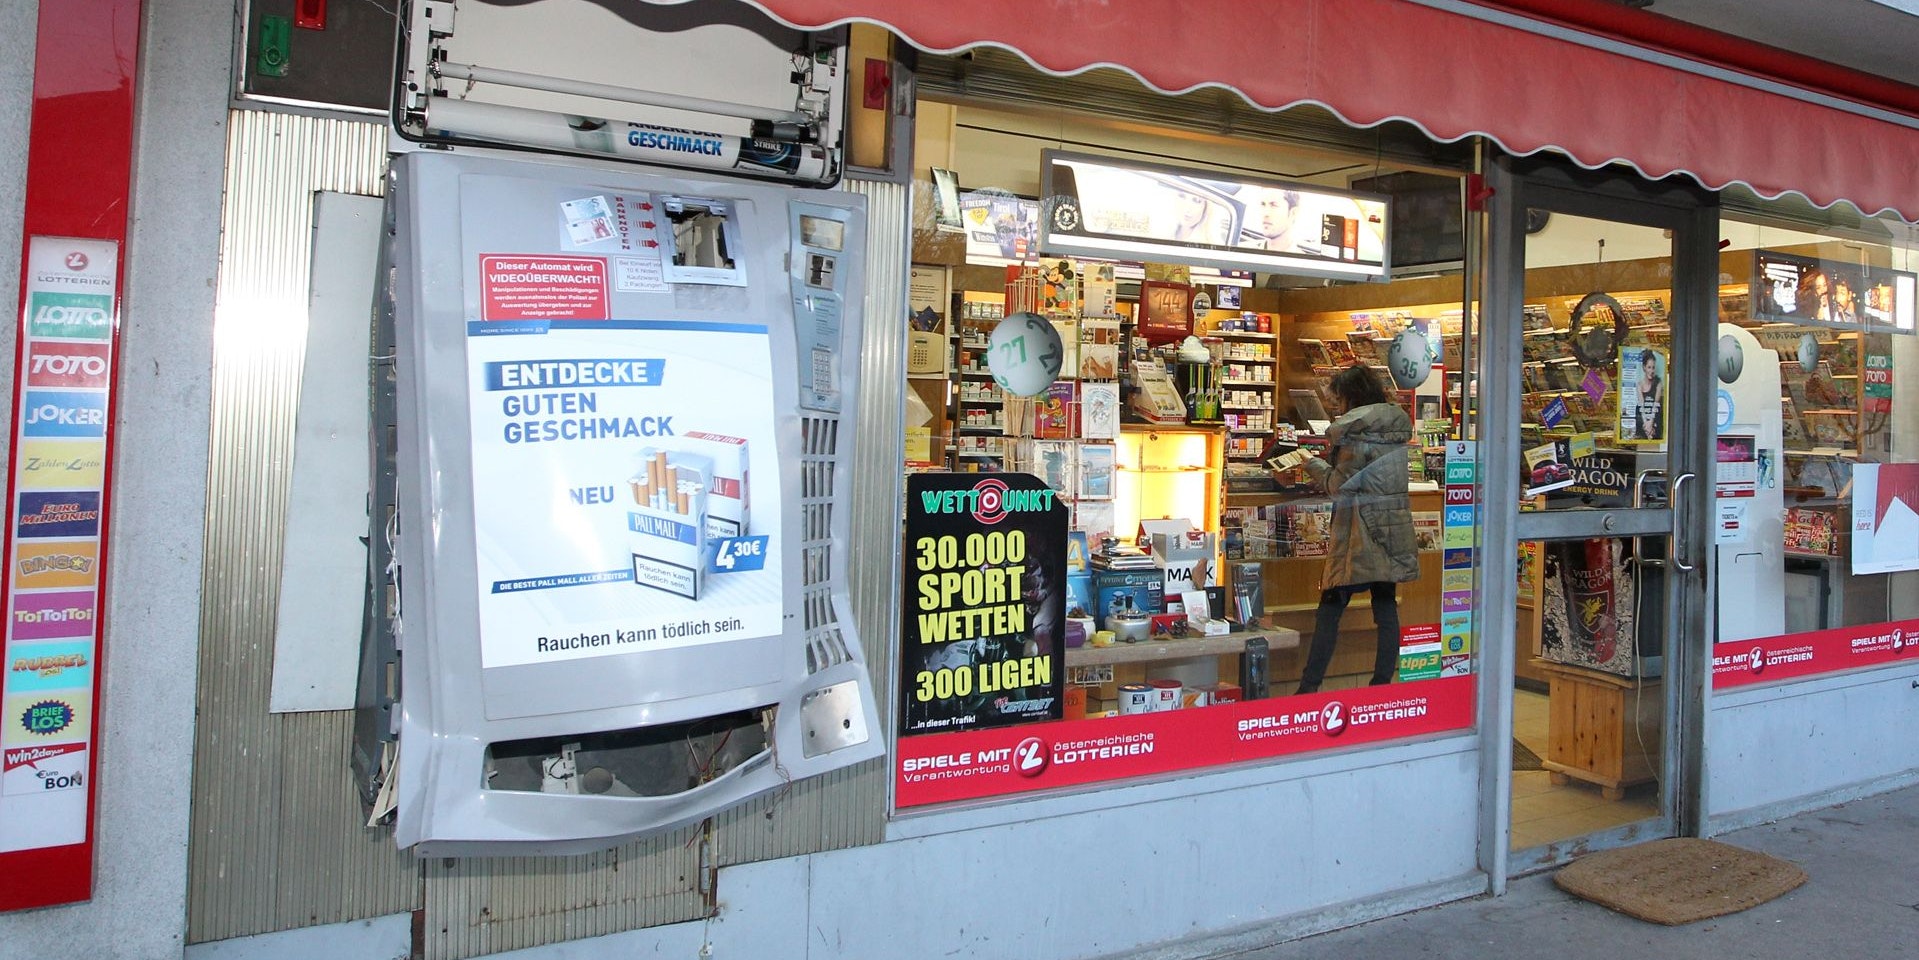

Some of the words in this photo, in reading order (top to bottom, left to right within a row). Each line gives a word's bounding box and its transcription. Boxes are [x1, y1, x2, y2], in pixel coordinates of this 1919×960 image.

[628, 130, 722, 157] GESCHMACK
[496, 262, 527, 270] Dieser
[530, 262, 571, 271] Automat
[572, 263, 593, 272] wird
[38, 276, 111, 286] LOTTERIEN
[489, 272, 600, 284] VIDEOÜBERWACHT!
[34, 305, 109, 326] LOTTO
[31, 354, 106, 376] TOTO
[501, 361, 648, 387] ENTDECKE
[1400, 357, 1419, 379] 35
[503, 392, 597, 417] GUTEN
[27, 404, 104, 426] JOKER
[504, 416, 674, 444] GESCHMACK
[1572, 457, 1612, 470] WILD
[1448, 467, 1473, 479] LOTTO
[1568, 468, 1629, 489] RAGON
[569, 485, 614, 506] NEU
[1447, 489, 1472, 500] TOTO
[1562, 486, 1592, 494] ENERGY
[1594, 488, 1619, 496] DRINK
[1447, 510, 1472, 522] JOKER
[634, 515, 654, 532] PALL
[654, 519, 677, 539] MALL
[915, 529, 1026, 572] 30.000
[639, 563, 671, 578] Rauchen
[673, 571, 691, 583] kann
[643, 573, 669, 586] tödlich
[1167, 565, 1213, 582] MAK
[1573, 569, 1603, 579] WILD
[499, 582, 512, 590] DIE
[513, 580, 537, 589] BESTE
[537, 579, 557, 587] PALL
[557, 577, 578, 585] MALL
[917, 566, 1026, 611] SPORT
[917, 603, 1026, 645] WETTEN
[537, 632, 611, 653] Rauchen
[615, 628, 657, 644] kann
[661, 619, 711, 639] tödlich
[714, 616, 745, 633] sein.
[1851, 636, 1877, 647] SPIELE
[1877, 634, 1891, 643] MIT
[1766, 645, 1813, 657] österreichische
[1851, 644, 1891, 654] Verantwortung
[1732, 653, 1748, 664] MIT
[1766, 652, 1813, 666] LOTTERIEN
[915, 665, 973, 702] 300
[979, 654, 1051, 694] LIGEN
[32, 707, 64, 717] BRIEF
[1351, 697, 1427, 714] österreichische
[31, 717, 65, 730] LOS
[926, 718, 950, 728] dieser
[951, 715, 976, 725] Trafik!
[1238, 714, 1289, 731] SPIELE
[1294, 710, 1320, 724] MIT
[1350, 705, 1427, 725] LOTTERIEN
[1053, 732, 1154, 751] österreichische
[1238, 724, 1319, 741] Verantwortung
[903, 752, 971, 772] SPIELE
[978, 747, 1012, 764] MIT
[1053, 742, 1154, 765] LOTTERIEN
[903, 763, 1010, 783] Verantwortung
[45, 775, 82, 790] BON
